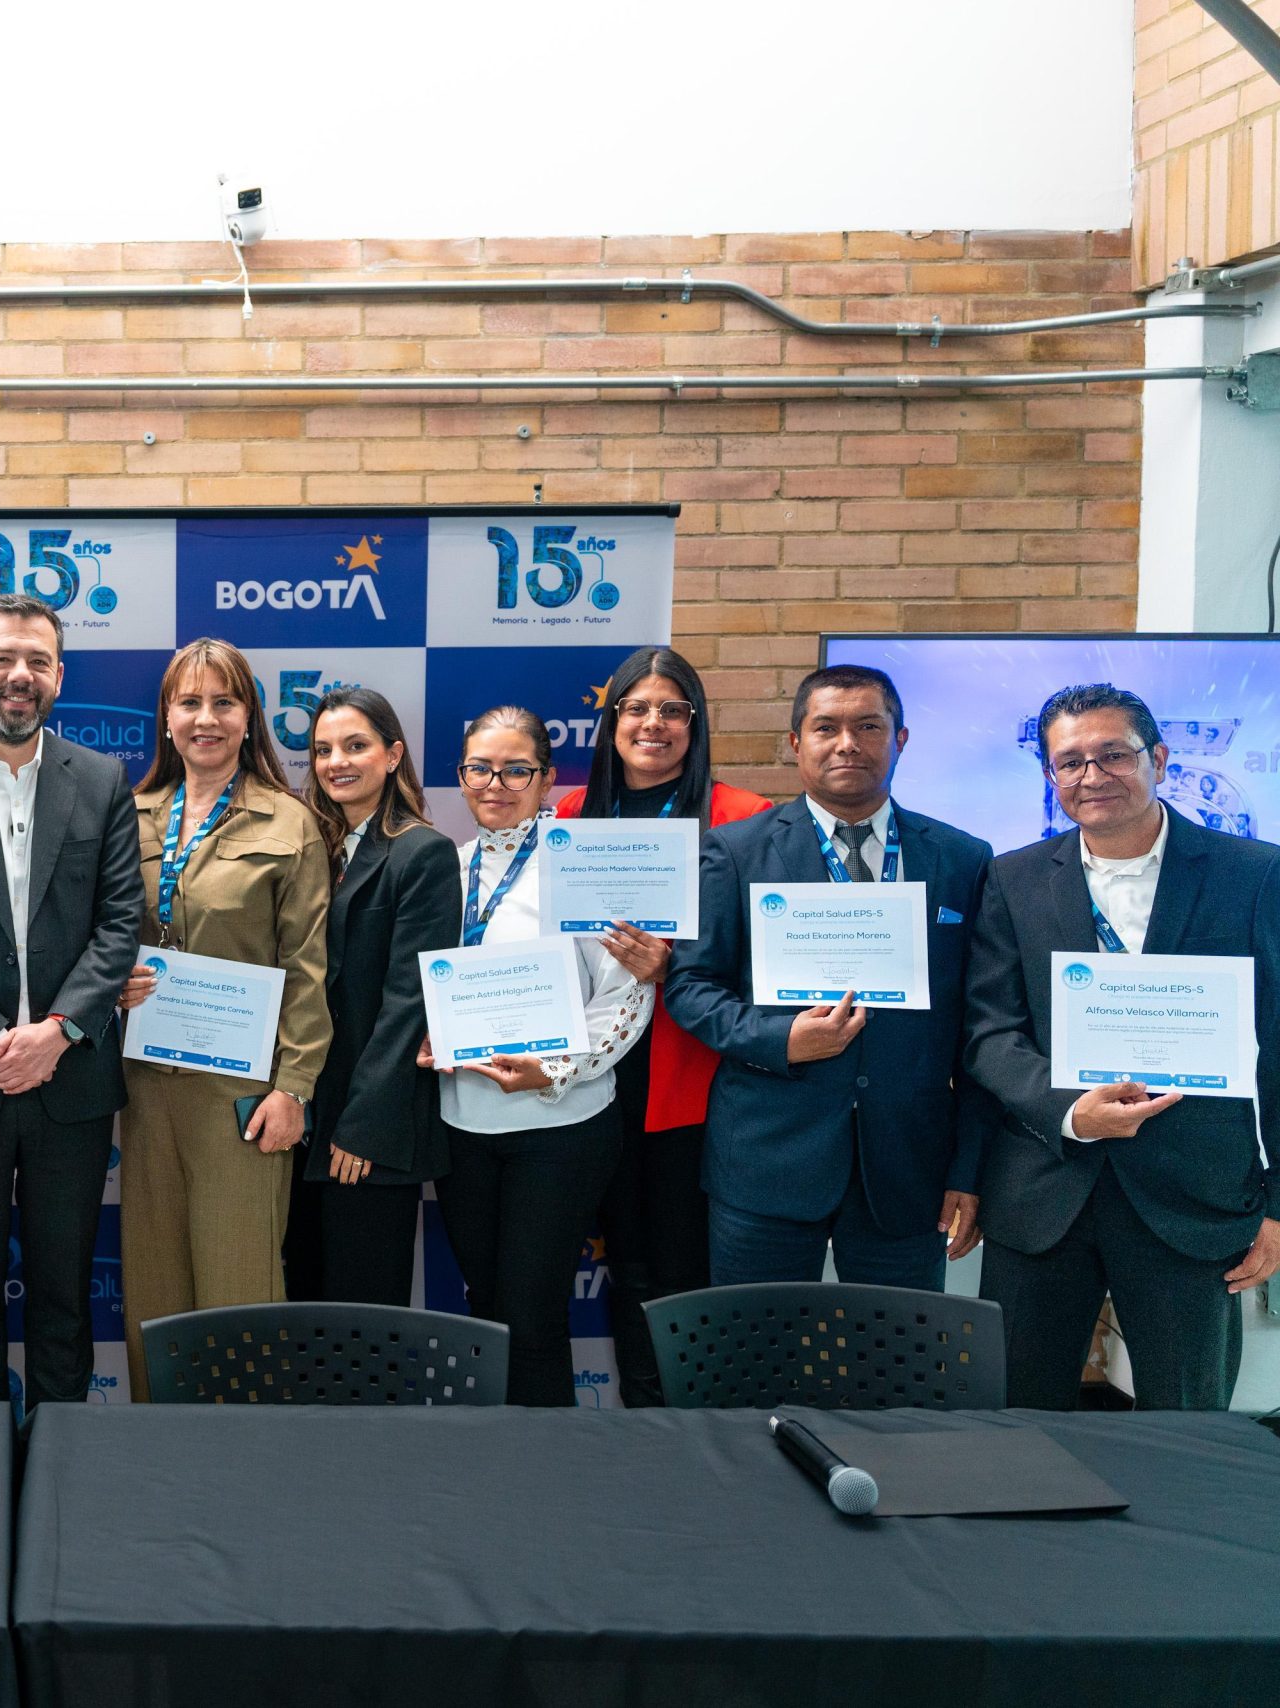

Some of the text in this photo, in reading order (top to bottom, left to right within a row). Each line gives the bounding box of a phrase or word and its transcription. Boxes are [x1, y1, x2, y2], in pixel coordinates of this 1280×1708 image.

[73, 540, 112, 554] años
[577, 536, 616, 551] años
[487, 526, 583, 609] 15
[540, 617, 571, 625] Legado
[584, 616, 611, 624] Futuro
[576, 845, 605, 853] Capital
[792, 910, 883, 919] Capital Salud EPS-S
[459, 971, 487, 982] Capital
[488, 968, 512, 977] Salud
[513, 964, 539, 974] EPS-S
[170, 976, 197, 987] Capital
[198, 981, 220, 991] Salud
[221, 984, 247, 995] EPS-S
[1099, 983, 1204, 995] Capital Salud EPS-S
[452, 993, 476, 1002] Eileen
[477, 990, 501, 999] Astrid
[534, 984, 553, 992] Arce
[156, 994, 180, 1004] Sandra
[203, 1001, 227, 1012] Vargas
[1085, 1006, 1124, 1015] Alfonso
[1125, 1007, 1165, 1016] Velasco
[89, 1374, 117, 1387] ños
